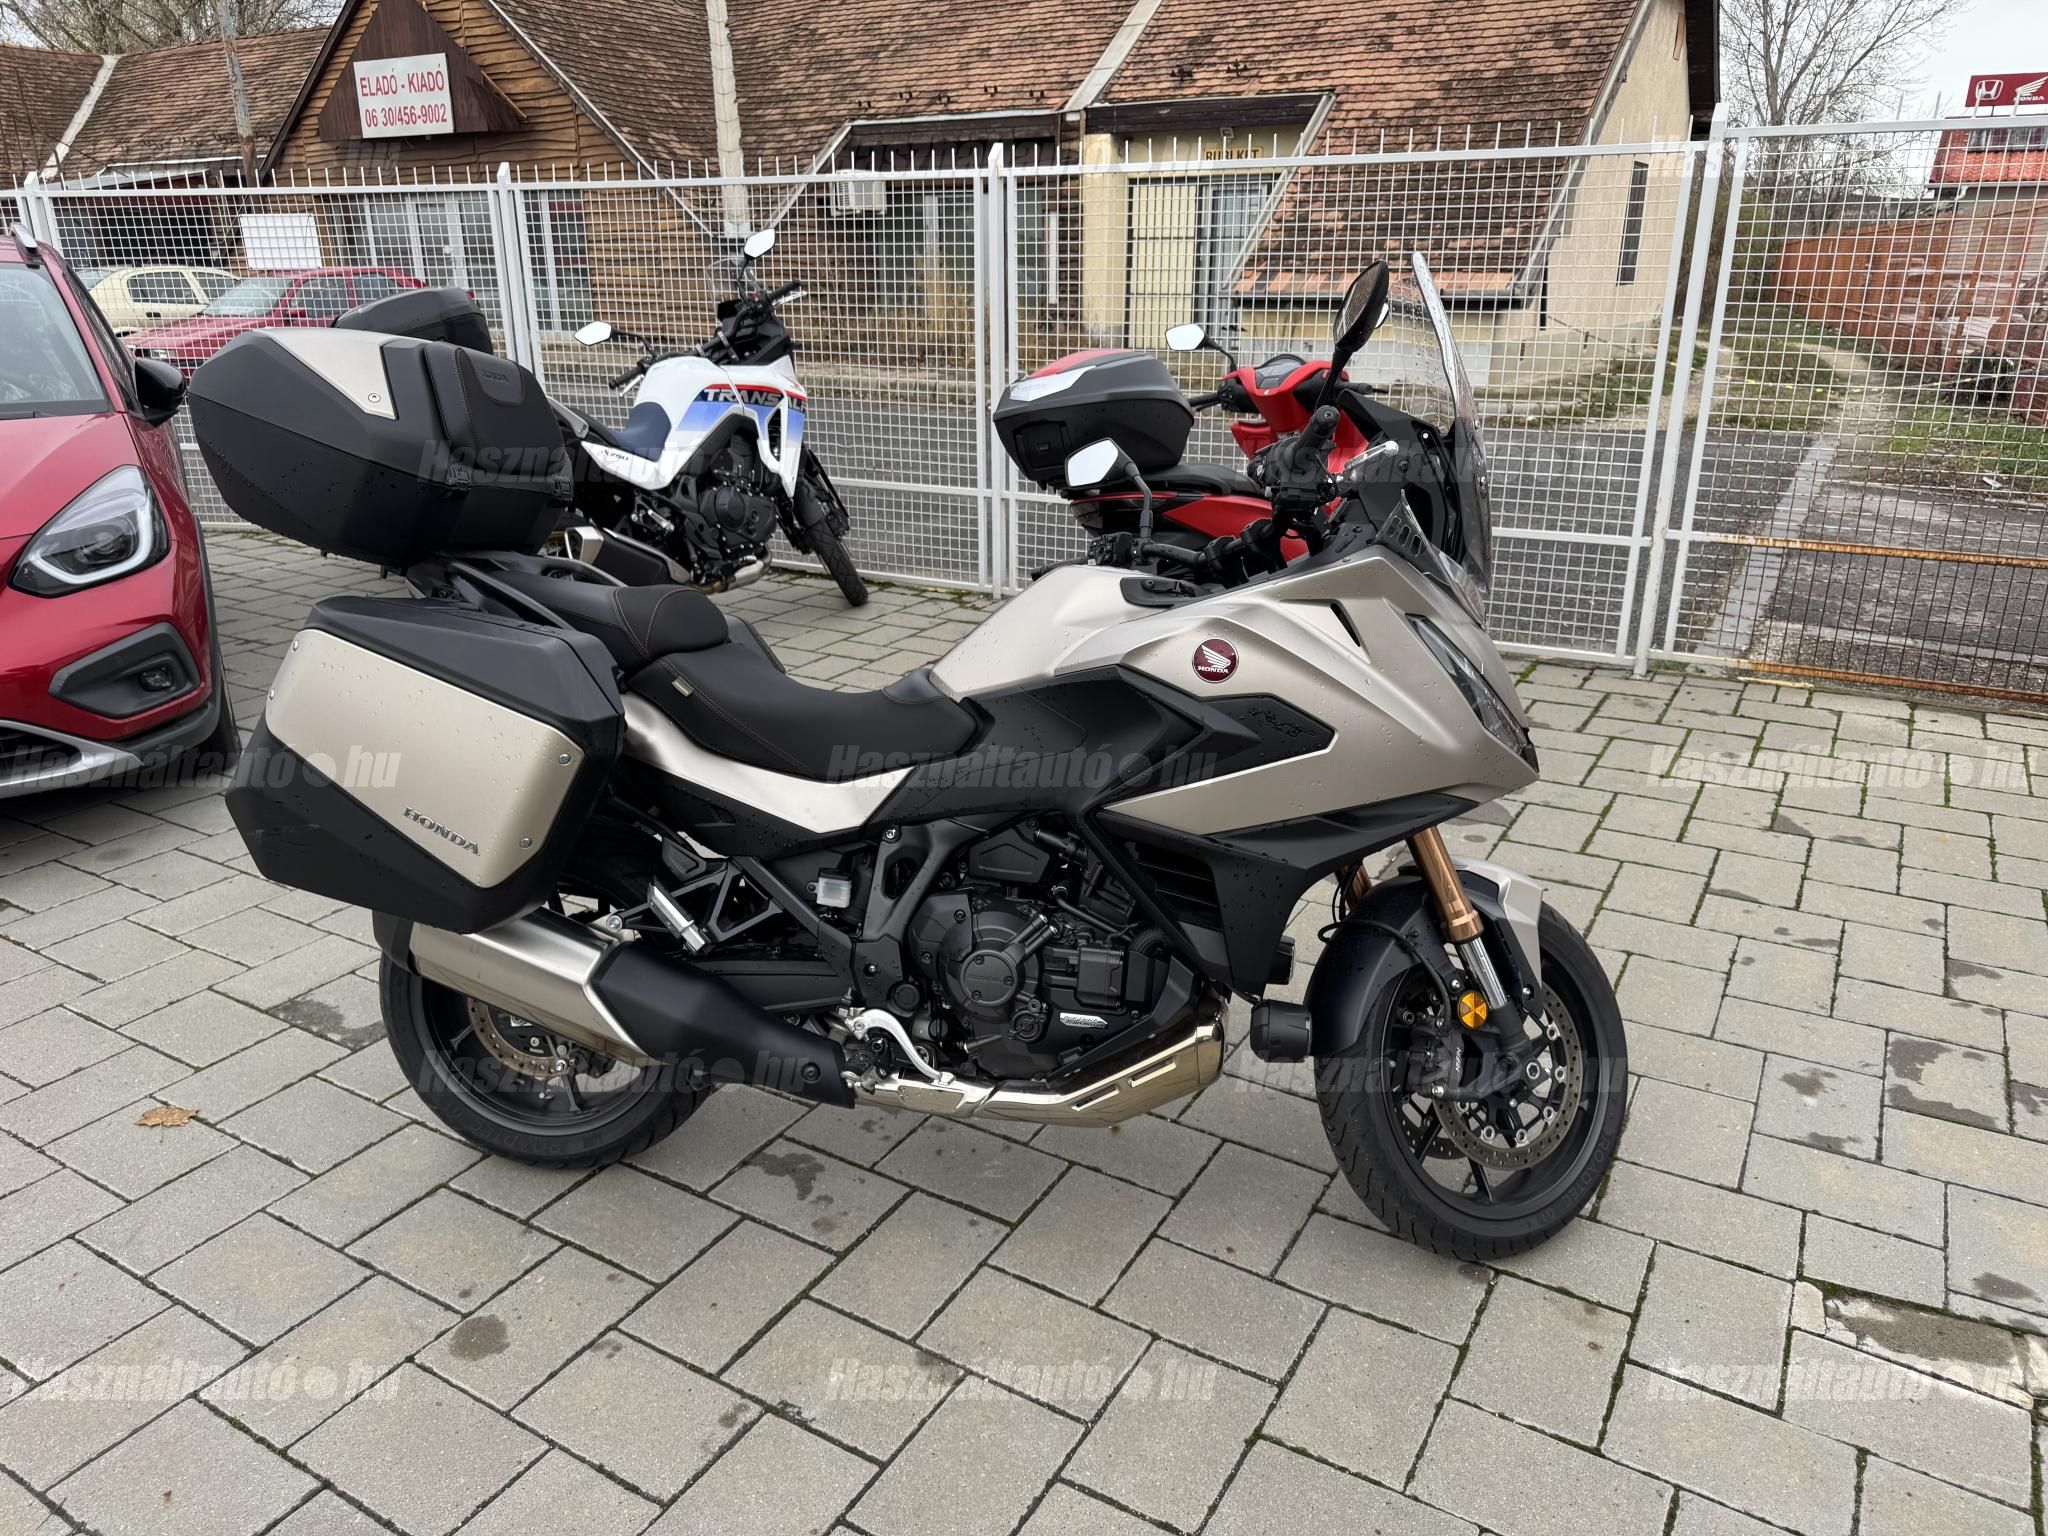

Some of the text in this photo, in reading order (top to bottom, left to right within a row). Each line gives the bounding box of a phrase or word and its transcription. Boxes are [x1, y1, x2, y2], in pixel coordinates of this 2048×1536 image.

[360, 67, 398, 97] ELADÓ
[407, 63, 445, 93] KIADÓ
[365, 103, 448, 128] 06 30/456-9002
[1197, 665, 1229, 674] HONDA
[403, 806, 481, 857] HONDA
[1563, 1136, 1610, 1208] ROADTEC
